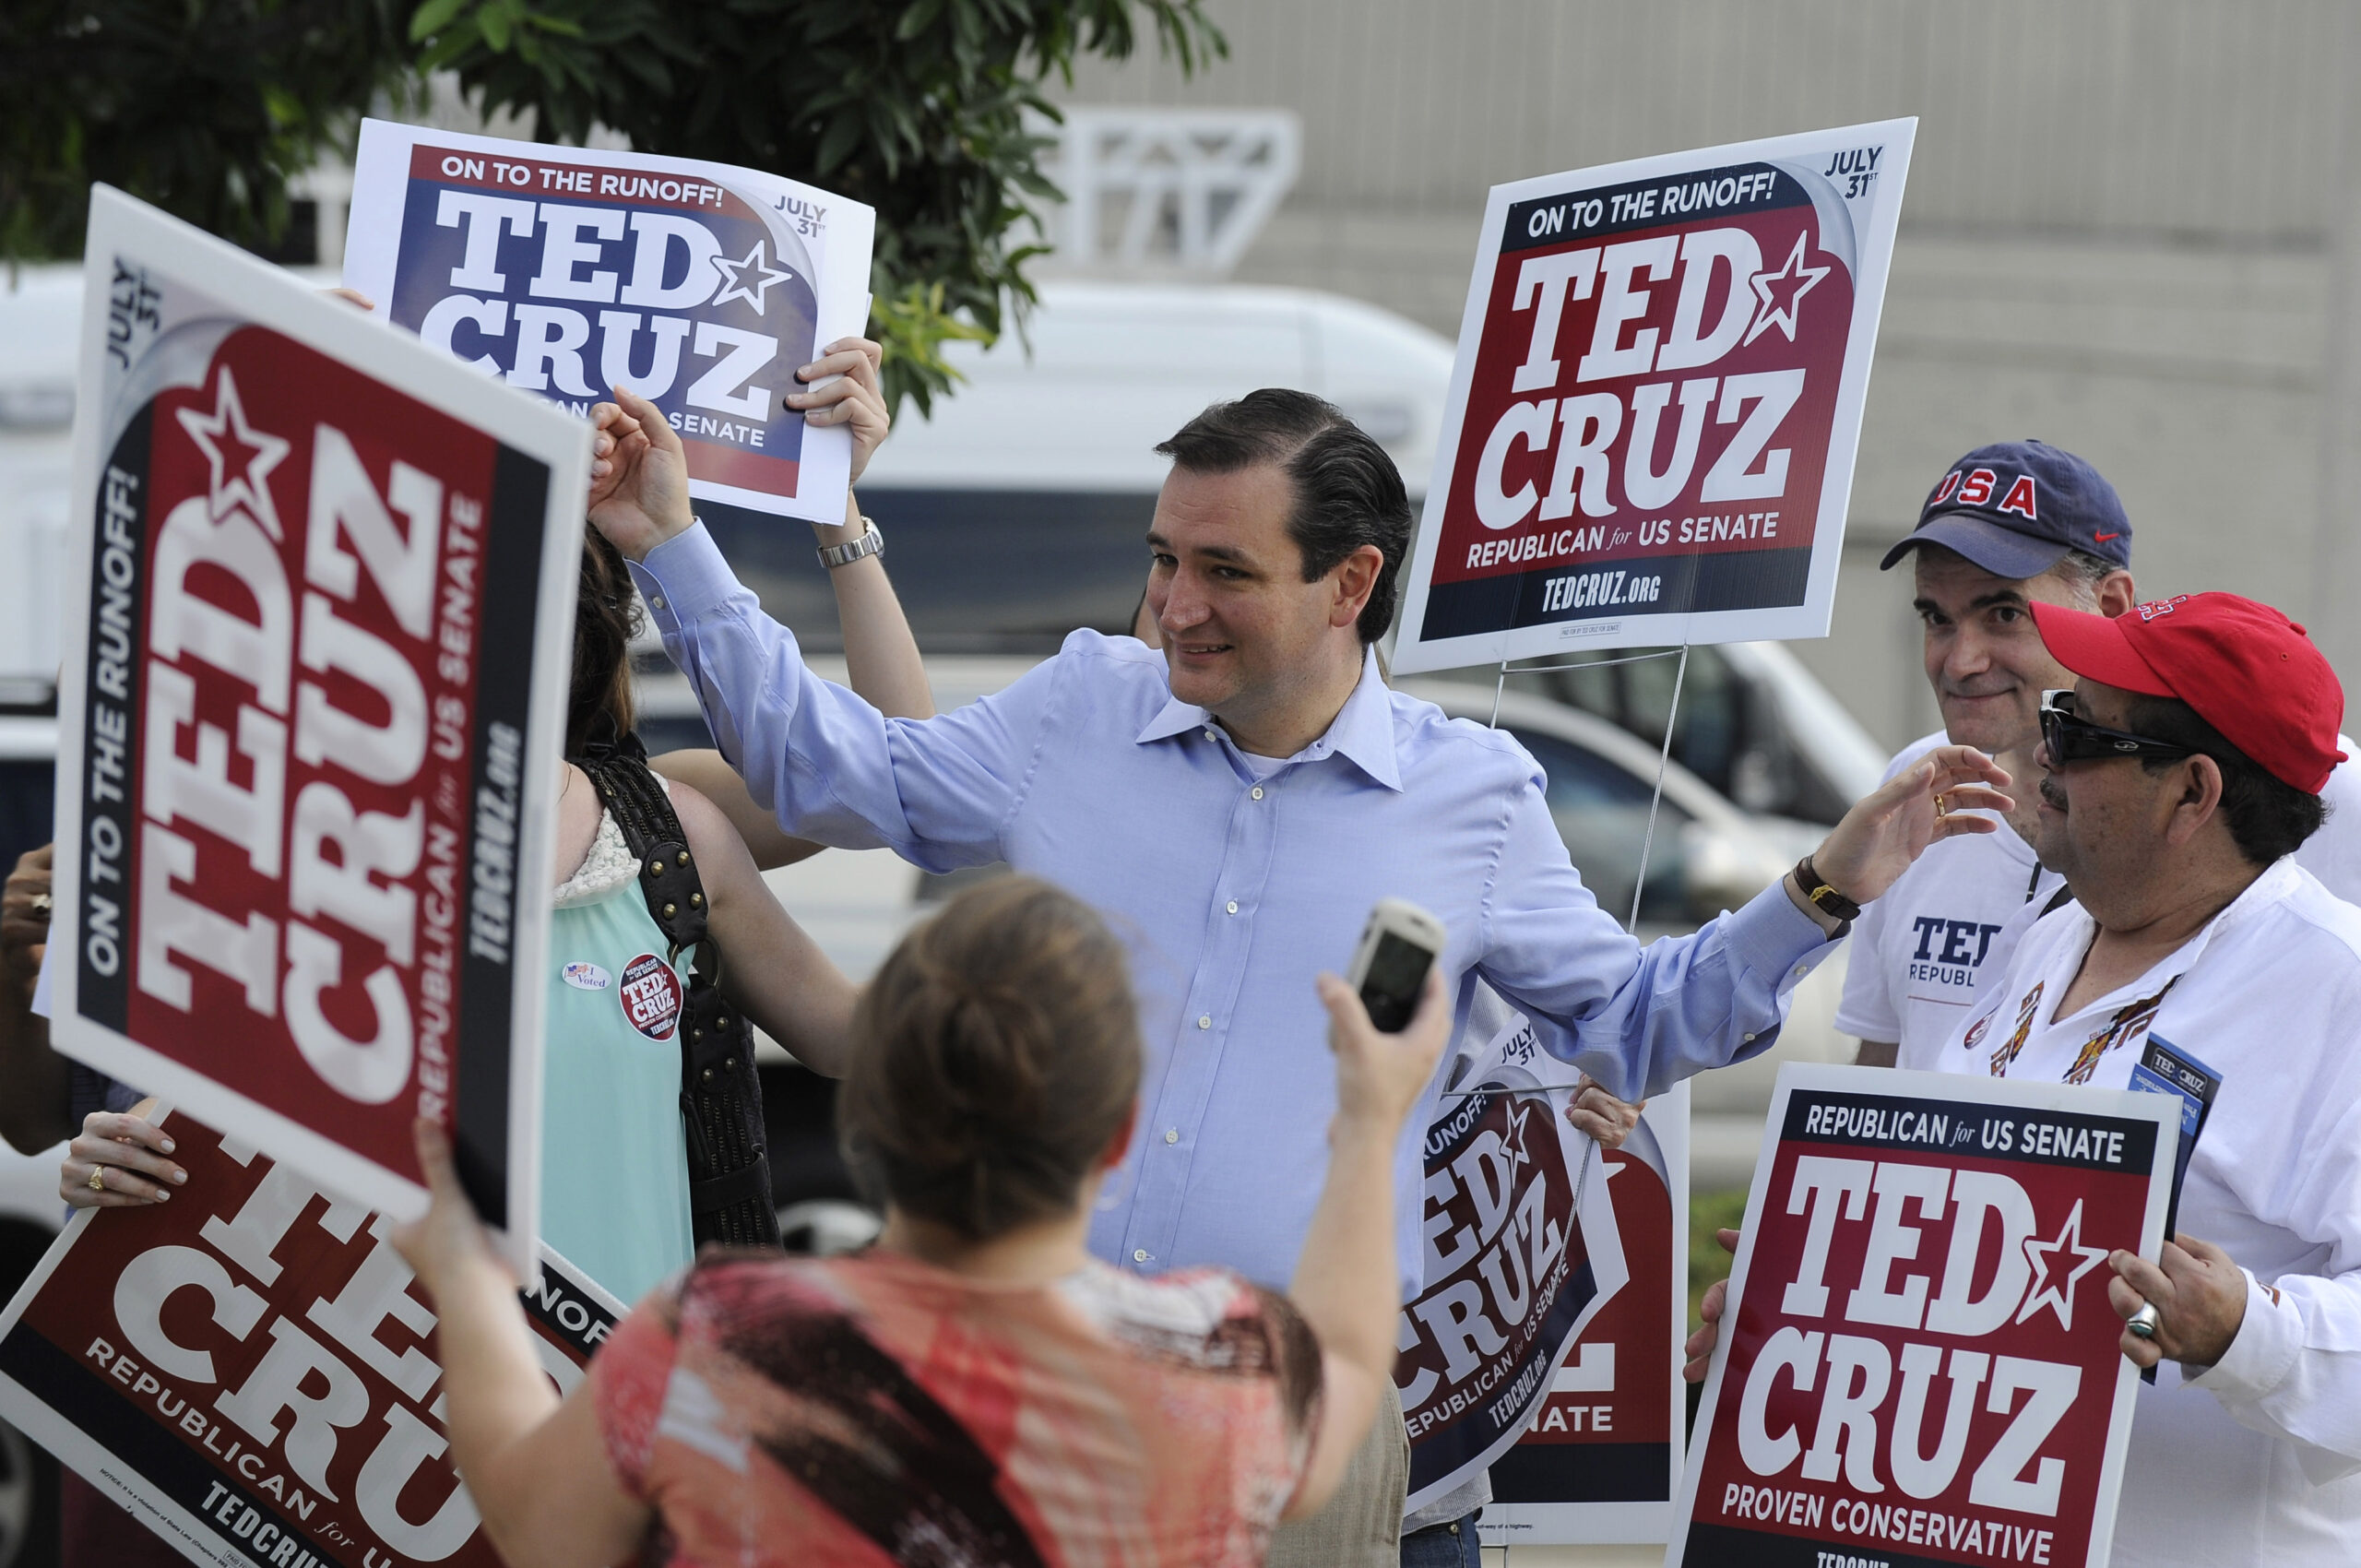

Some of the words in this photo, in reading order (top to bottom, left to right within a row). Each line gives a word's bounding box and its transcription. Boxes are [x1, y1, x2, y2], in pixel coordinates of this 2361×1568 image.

[441, 156, 484, 179] ON
[492, 162, 530, 186] TO
[540, 168, 593, 195] THE
[600, 174, 724, 208] RUNOFF!
[1823, 146, 1883, 178] JULY
[774, 196, 826, 222] JULY
[1527, 206, 1564, 238] ON
[1572, 199, 1604, 229] TO
[1609, 188, 1655, 222] THE
[1660, 171, 1776, 216] RUNOFF!
[436, 189, 724, 310] TED
[107, 257, 136, 370] JULY
[1511, 227, 1762, 394] TED
[421, 294, 778, 422] CRUZ
[669, 412, 765, 447] SENATE
[1474, 368, 1807, 530] CRUZ
[1930, 469, 2036, 519] USA
[97, 465, 139, 697] RUNOFF!
[1466, 526, 1605, 569] REPUBLICAN
[1606, 527, 1632, 551] for
[1638, 518, 1670, 546] US
[1678, 511, 1779, 543] SENATE
[439, 494, 483, 683] SENATE
[1542, 571, 1660, 612] TEDCRUZ.ORG
[93, 704, 127, 809] THE
[137, 495, 293, 1017] TED
[283, 422, 445, 1105] CRUZ
[434, 698, 468, 762] US
[90, 815, 123, 885] TO
[87, 896, 121, 978] ON
[419, 824, 459, 1122] REPUBLICAN
[1909, 964, 1975, 987] REPUBL
[578, 975, 606, 987] Voted
[622, 972, 662, 1004] TED
[632, 987, 675, 1023] CRUZ
[1501, 1024, 1533, 1063] JULY
[2154, 1054, 2175, 1074] TED
[2179, 1069, 2205, 1092] CRUZ
[1805, 1104, 1948, 1146] REPUBLICAN
[1948, 1119, 1975, 1147] for
[1982, 1116, 2013, 1152] US
[2020, 1122, 2126, 1164] SENATE
[1423, 1130, 1513, 1290] ED
[1780, 1154, 2036, 1337] TED
[114, 1246, 482, 1562] CRU
[1404, 1352, 1513, 1438] EPUBLICAN
[1513, 1340, 1525, 1362] for
[1524, 1315, 1537, 1342] US
[86, 1338, 316, 1521] REPUBLICAN
[314, 1522, 354, 1548] for
[1738, 1326, 2082, 1518] CRUZ
[1721, 1482, 1825, 1529] PROVEN
[1831, 1498, 2054, 1566] CONSERVATIVE
